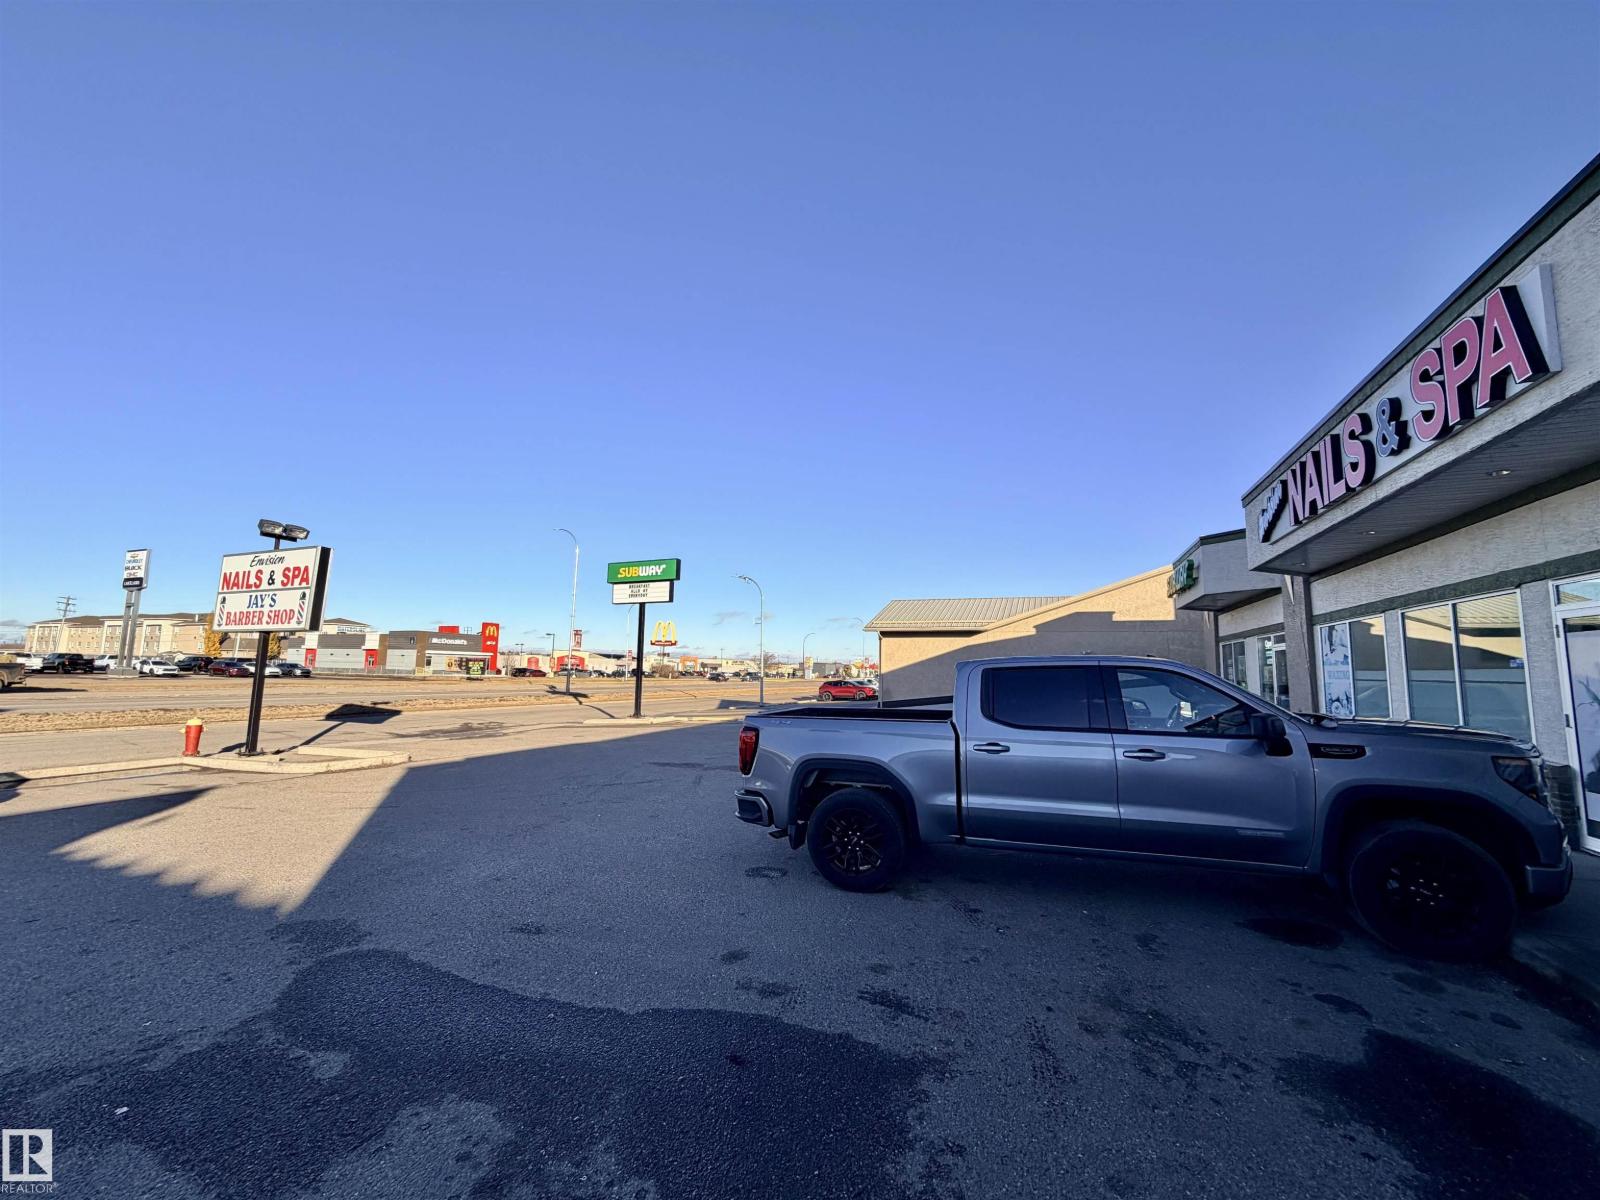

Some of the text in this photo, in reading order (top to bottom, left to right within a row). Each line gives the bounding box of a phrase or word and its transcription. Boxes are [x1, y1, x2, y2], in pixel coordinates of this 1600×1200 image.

[1286, 412, 1368, 527] NAILS
[1376, 398, 1400, 458] &
[1410, 287, 1533, 443] SPA
[250, 555, 285, 567] Envision
[221, 565, 310, 591] NAILS & SPA
[618, 564, 666, 578] SUBWAY
[246, 593, 277, 609] JAY'S
[225, 609, 295, 626] BARBER SHOP
